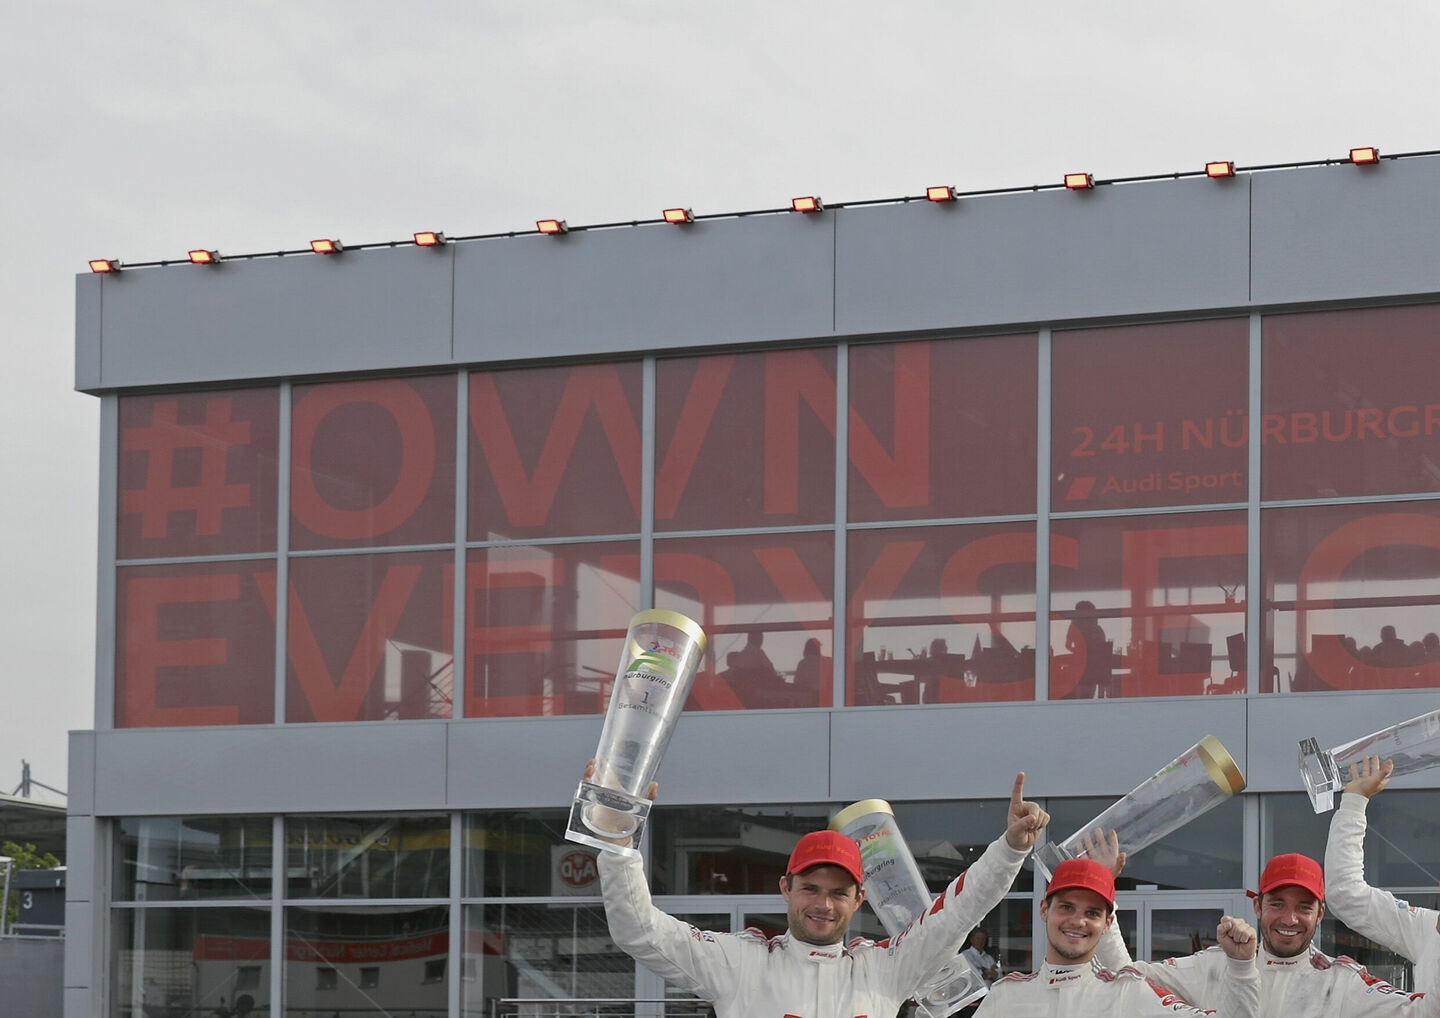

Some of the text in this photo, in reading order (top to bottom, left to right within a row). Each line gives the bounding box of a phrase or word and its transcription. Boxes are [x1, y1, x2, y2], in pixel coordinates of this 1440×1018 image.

[122, 341, 930, 540] #OWN
[1071, 421, 1166, 458] 24H
[1100, 470, 1243, 495] Audi Sport
[23, 891, 33, 910] 3
